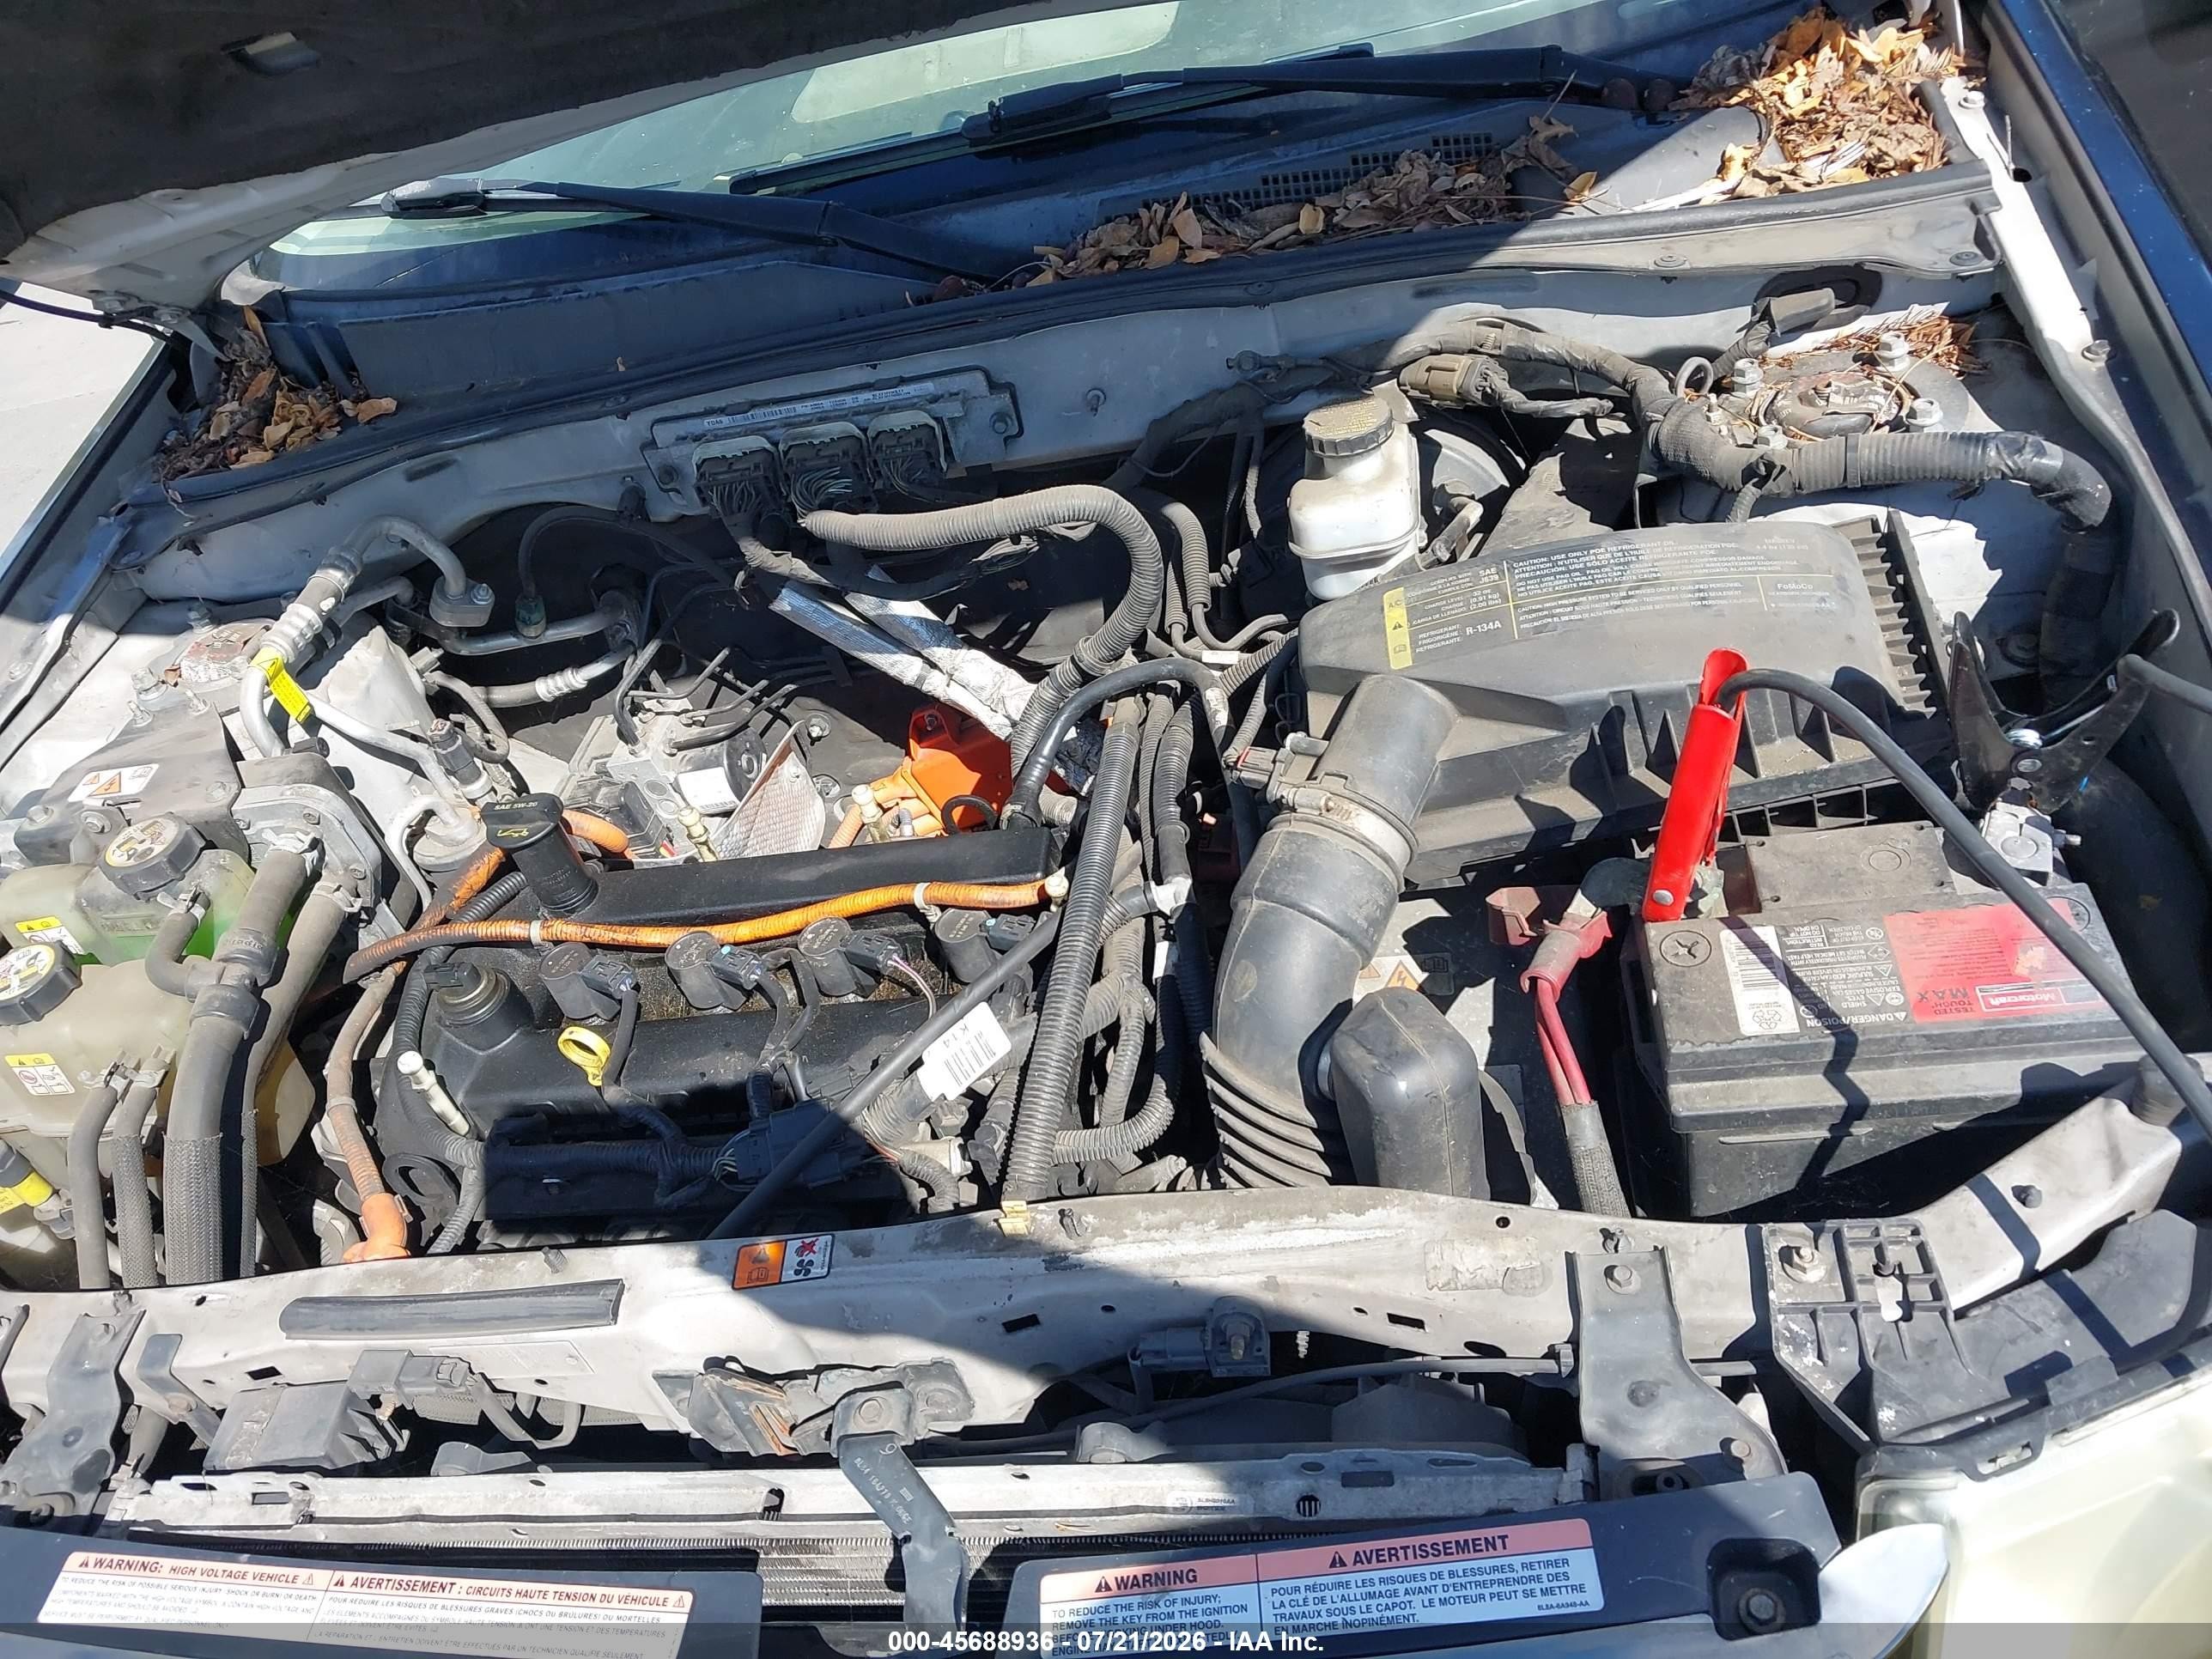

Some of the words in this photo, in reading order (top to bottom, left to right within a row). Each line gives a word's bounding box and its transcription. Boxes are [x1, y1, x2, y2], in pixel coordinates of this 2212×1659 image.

[1479, 567, 1497, 576] SAE
[1512, 556, 1549, 568] CAUTION:
[1513, 562, 1553, 574] ATTENTION
[1776, 580, 1813, 592] FoMoCo
[1465, 619, 1501, 635] R-134A
[1916, 987, 1968, 1001] MAX
[1988, 993, 2055, 1006] Motorcraft
[1807, 1012, 1894, 1027] DANGER/POISON
[1933, 1006, 1974, 1015] TESTED
[1351, 1534, 1510, 1566] AVERTISSEMENT
[93, 1557, 163, 1573] WARNING:
[168, 1565, 197, 1576] HIGH
[200, 1568, 248, 1580] VOLTAGE
[252, 1571, 299, 1583] VEHICLE
[1114, 1568, 1198, 1590] WARNING
[1271, 1584, 1301, 1597] POUR
[1304, 1577, 1352, 1594] RÉDUIRE
[1354, 1577, 1376, 1589] LES
[1378, 1571, 1426, 1586] RISQUES
[1429, 1570, 1445, 1581] DE
[1448, 1562, 1518, 1581] BLESSURES,
[1521, 1557, 1570, 1571] RETIRER
[350, 1574, 456, 1595] AVERTISSEMENT
[465, 1585, 512, 1598] CIRCUITS
[514, 1588, 549, 1600] HAUTE
[552, 1590, 597, 1603] TENSION
[599, 1593, 614, 1603] DU
[617, 1592, 669, 1607] VÉHICULE
[1271, 1600, 1285, 1610] LA
[1287, 1595, 1310, 1608] CLÉ
[1312, 1595, 1328, 1606] DE
[1329, 1588, 1400, 1605] L'ALLUMAGE
[1403, 1584, 1439, 1596] AVANT
[1442, 1573, 1543, 1594] D'ENTREPRENDRE
[1546, 1571, 1570, 1583] DES
[397, 1601, 427, 1609] RISQUES
[441, 1603, 482, 1613] BLESSURES
[484, 1606, 513, 1615] GRAVES
[545, 1609, 556, 1618] OU
[616, 1613, 660, 1625] MORTELLES
[1052, 1609, 1065, 1619] TO
[1068, 1604, 1111, 1617] REDUCE
[1115, 1601, 1134, 1613] THE
[1137, 1599, 1161, 1610] RISK
[1164, 1597, 1177, 1607] OF
[1180, 1593, 1221, 1607] INJURY;
[1273, 1608, 1322, 1623] TRAVAUX
[1325, 1605, 1356, 1618] SOUS
[1358, 1603, 1373, 1614] LE
[1376, 1599, 1415, 1613] CAPOT.
[1421, 1598, 1435, 1608] LE
[1438, 1592, 1486, 1607] MOTEUR
[1489, 1589, 1519, 1601] PEUT
[1521, 1588, 1537, 1599] SE
[1540, 1583, 1587, 1597] METTRE
[1052, 1619, 1095, 1631] REMOVE
[1098, 1616, 1119, 1626] THE
[1121, 1613, 1142, 1624] KEY
[1146, 1610, 1175, 1621] FROM
[1178, 1608, 1198, 1619] THE
[1201, 1603, 1248, 1616] IGNITION
[1189, 1618, 1223, 1631] HOOD.
[1273, 1625, 1290, 1636] EN
[1291, 1620, 1339, 1634] MARCHE
[1341, 1609, 1419, 1631] INOPINÉMENT.
